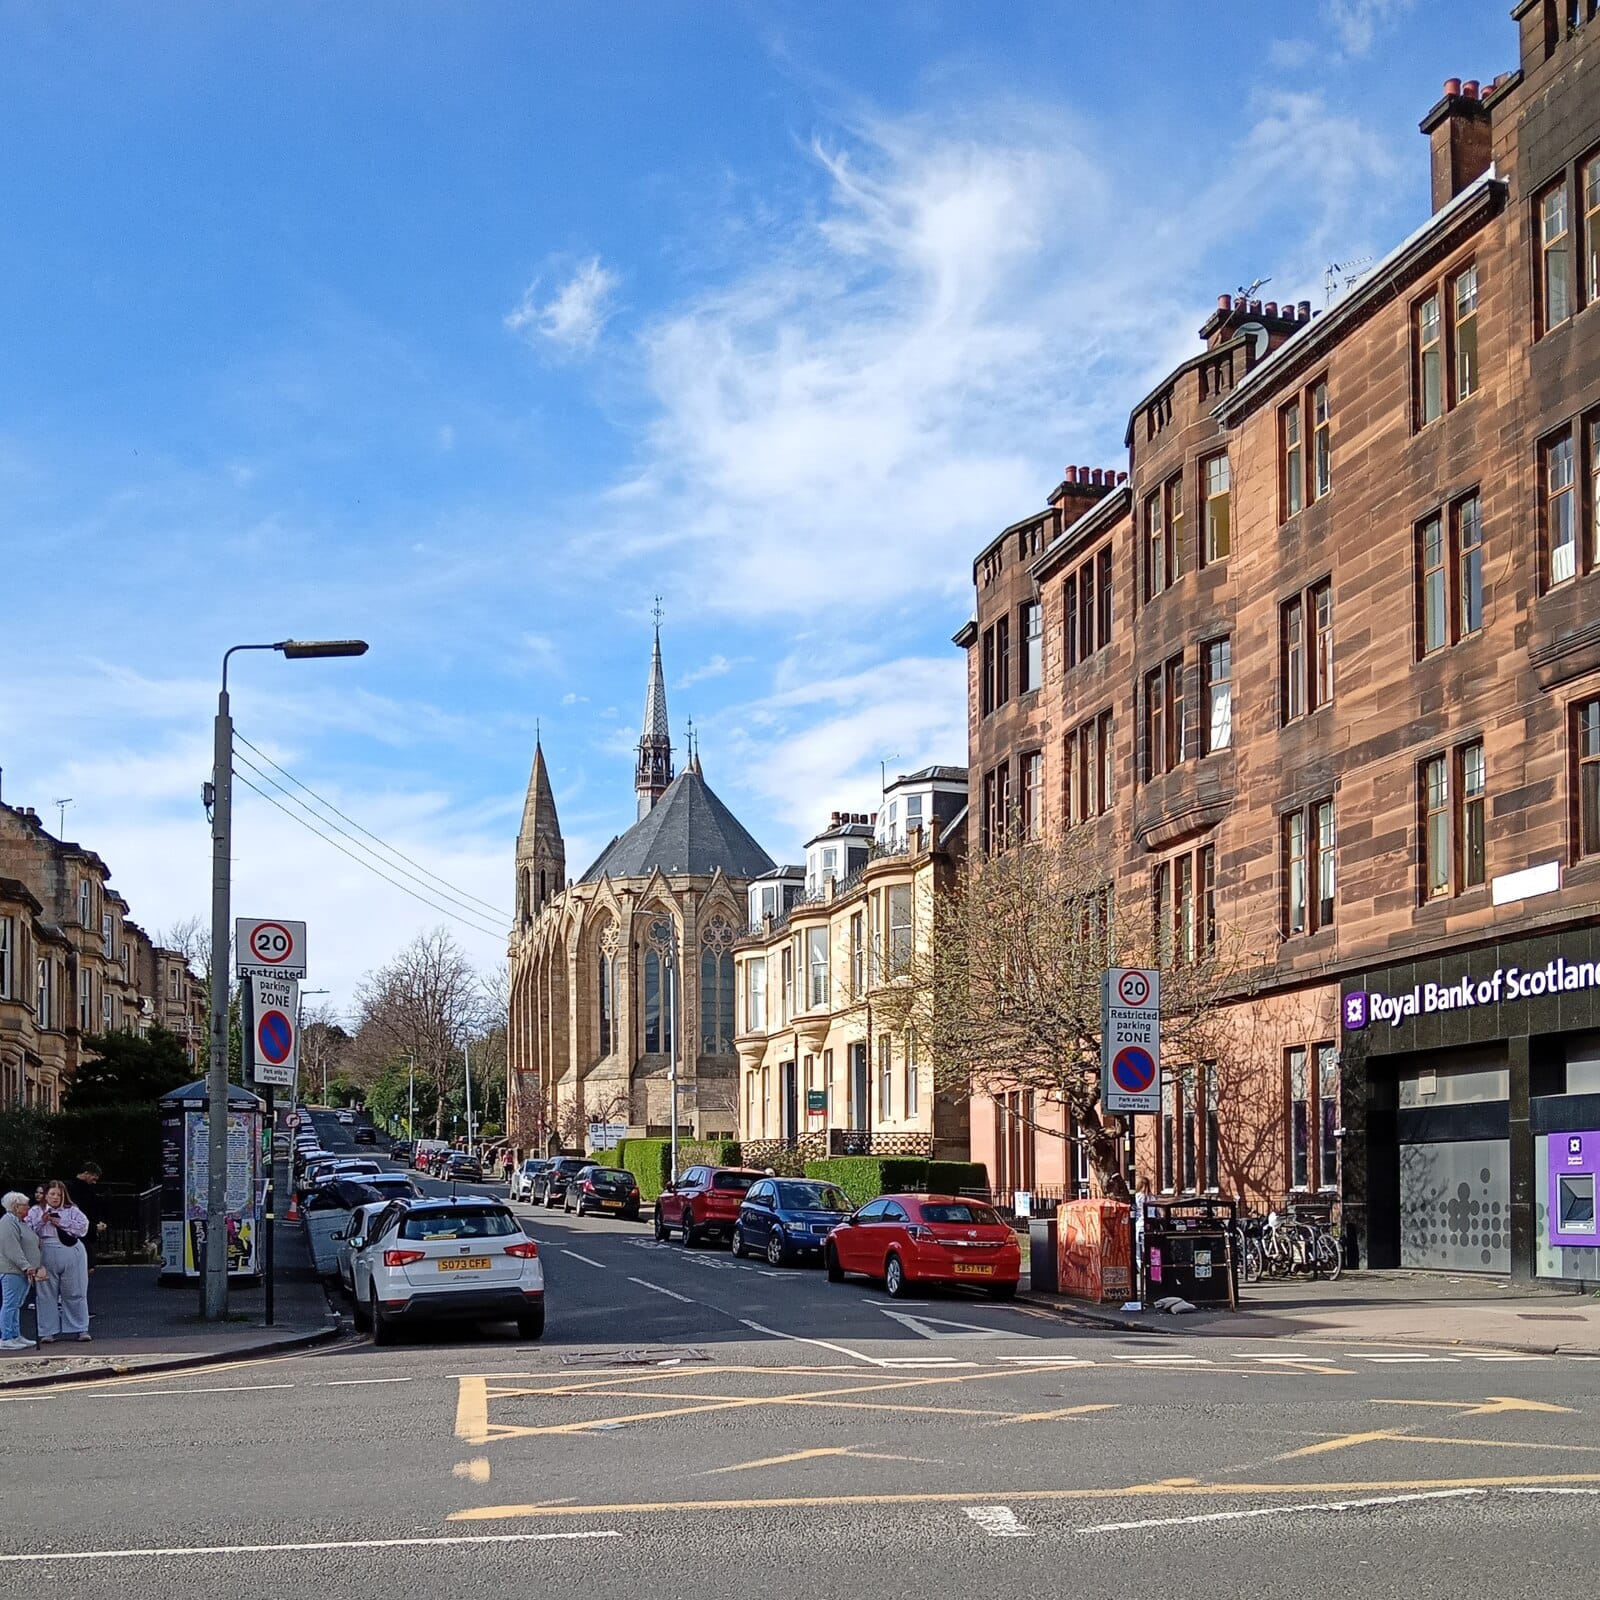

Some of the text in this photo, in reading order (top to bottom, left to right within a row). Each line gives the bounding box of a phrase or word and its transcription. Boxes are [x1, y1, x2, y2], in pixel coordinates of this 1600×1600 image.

[258, 934, 286, 952] 20
[241, 967, 303, 980] Restricted
[260, 981, 290, 994] parking
[1123, 981, 1146, 996] 20
[260, 993, 290, 1007] ZONE
[1370, 985, 1420, 1026] Royal
[1424, 976, 1477, 1012] Bank
[1477, 969, 1503, 1004] of
[1111, 1009, 1157, 1020] Restricted
[1117, 1021, 1151, 1031] parking
[1117, 1032, 1151, 1043] ZONE
[469, 1258, 488, 1268] CFF
